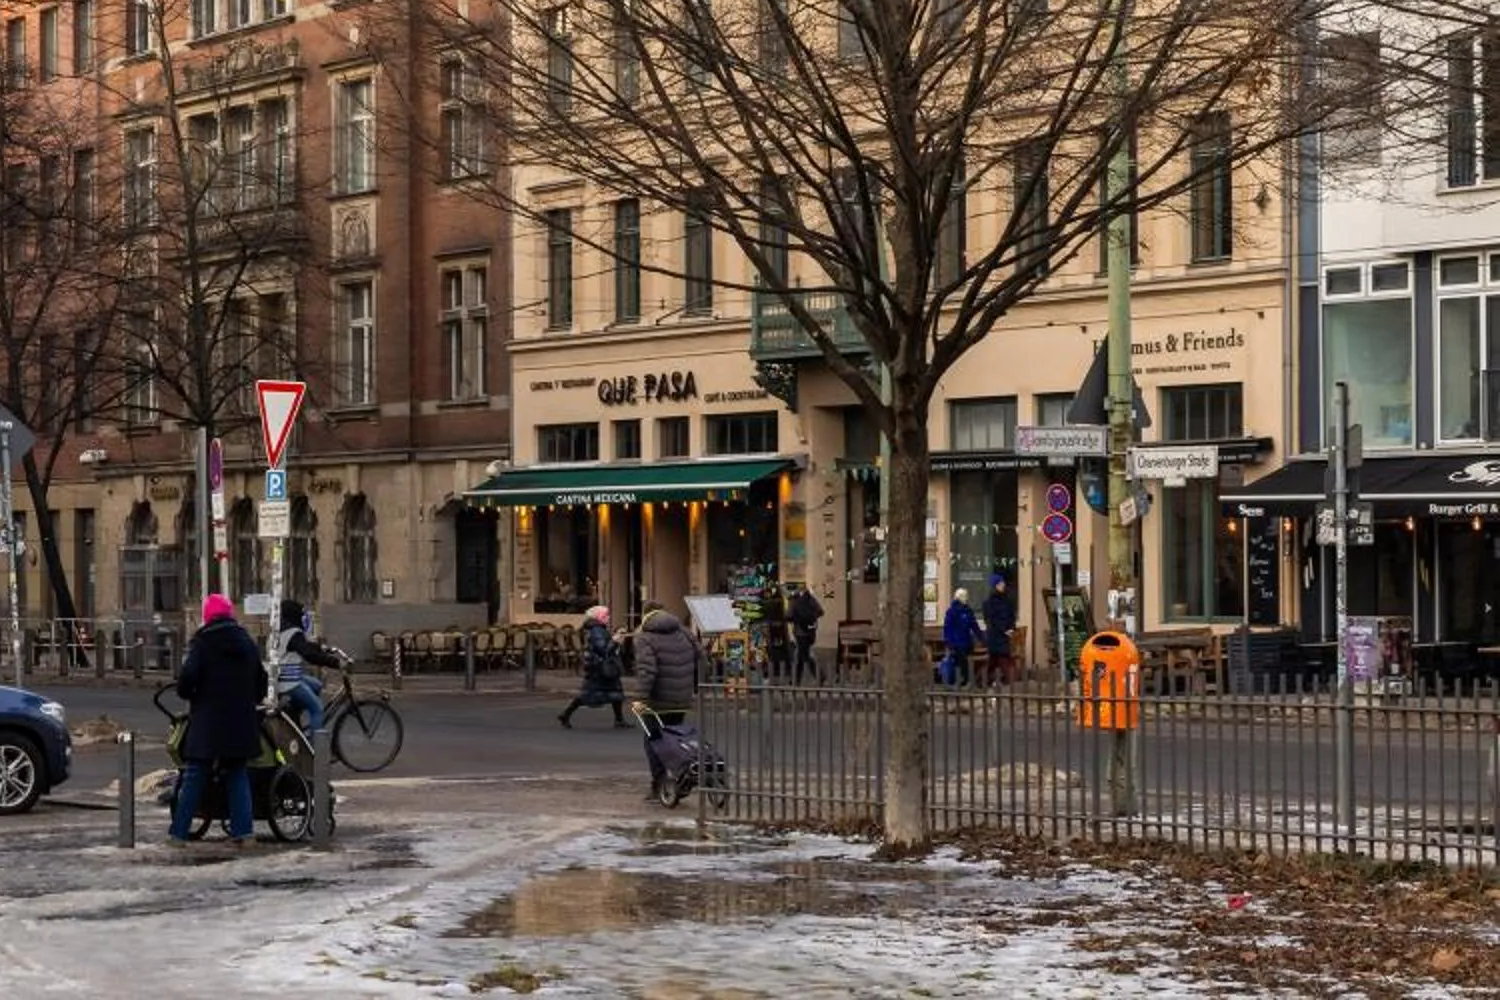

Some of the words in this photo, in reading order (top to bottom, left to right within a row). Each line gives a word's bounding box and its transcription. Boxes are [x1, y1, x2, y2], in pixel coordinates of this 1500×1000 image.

[1092, 339, 1162, 355] Hmus
[1166, 334, 1178, 352] &
[1183, 327, 1244, 351] Friends
[598, 375, 637, 406] QUE
[643, 371, 698, 403] PASA
[270, 473, 281, 497] P
[556, 495, 592, 505] CANTINA
[594, 493, 636, 503] MEXICANA
[1429, 503, 1463, 516] Burger
